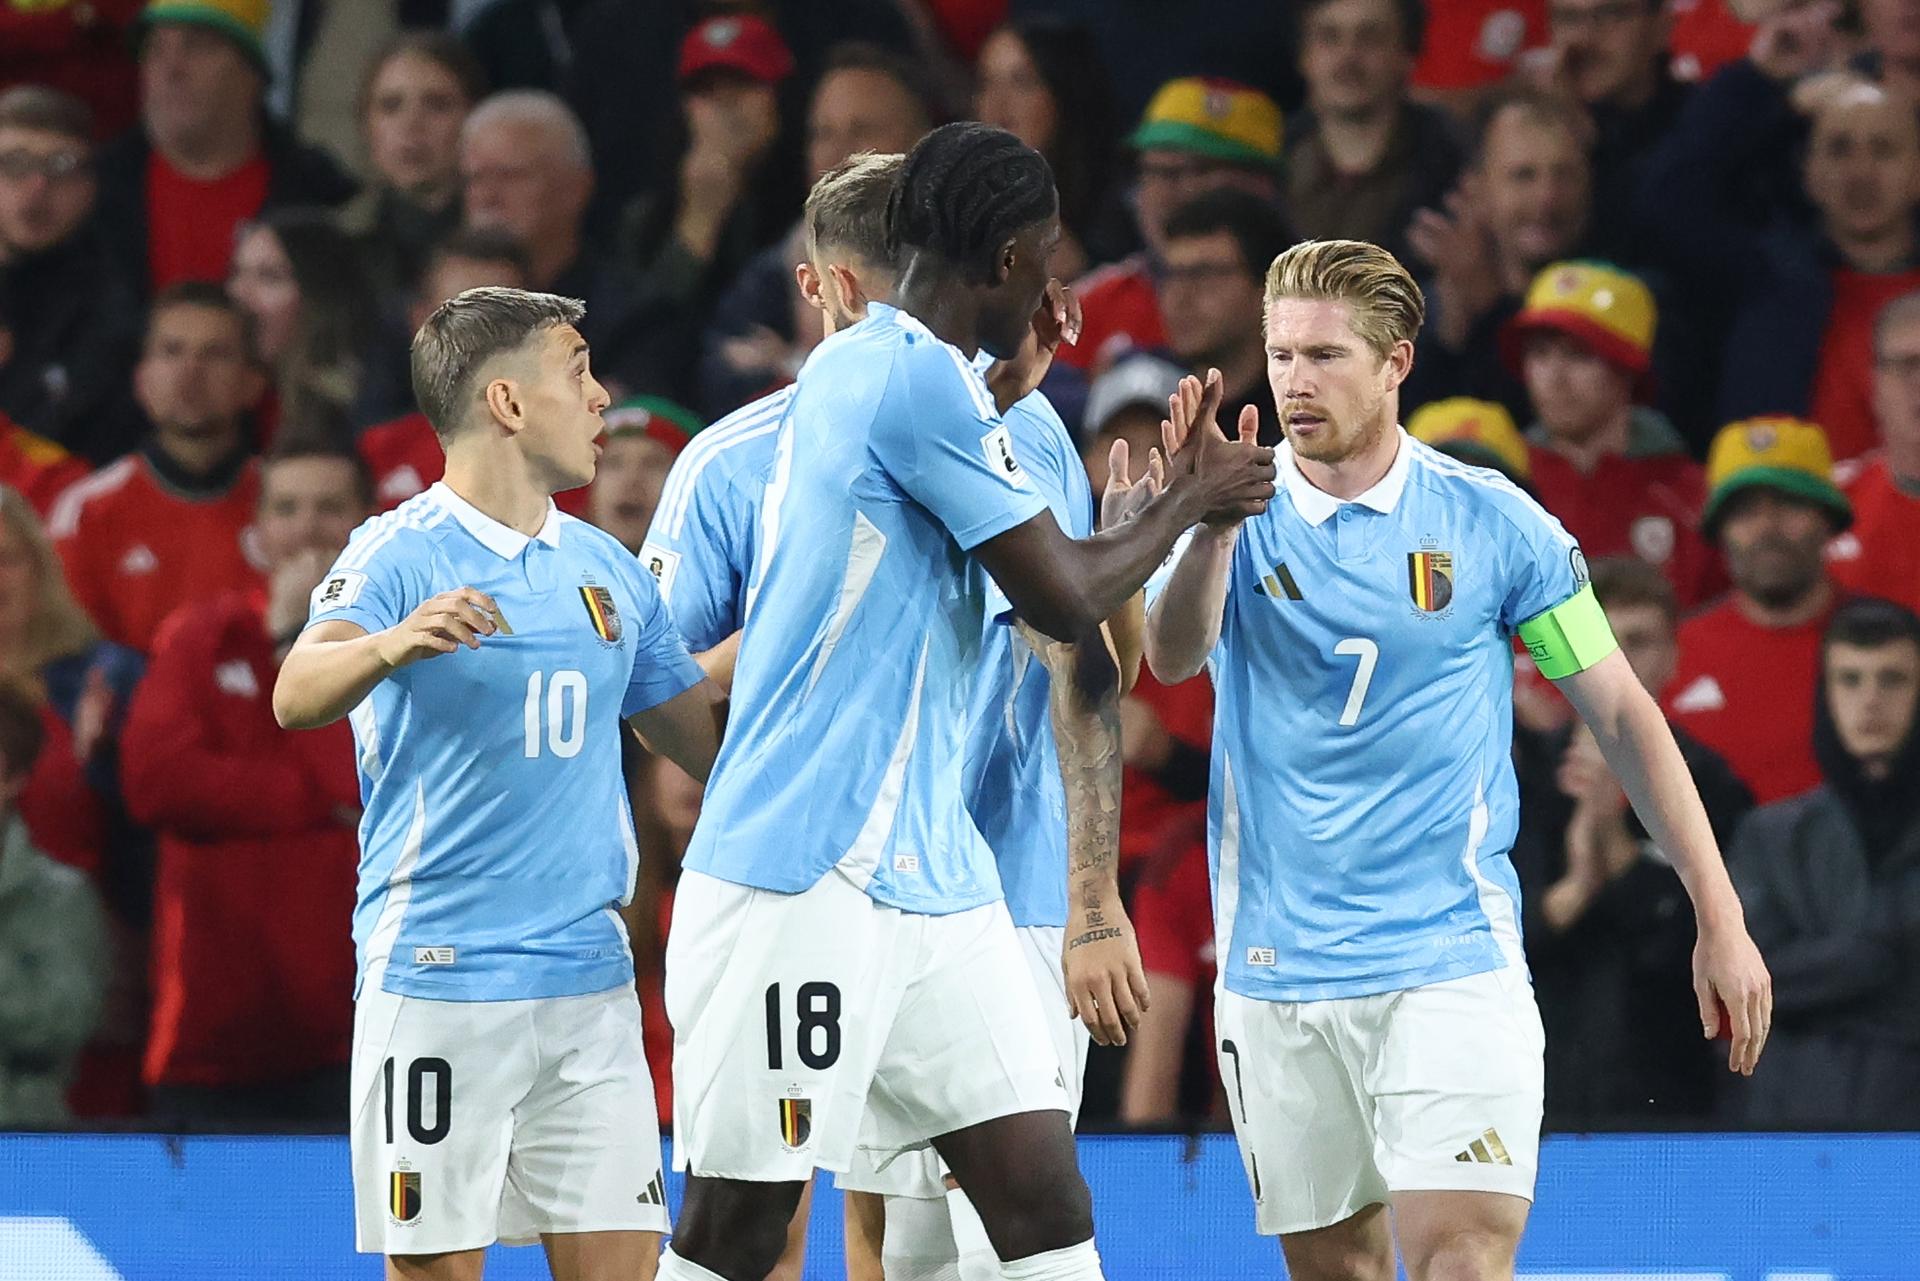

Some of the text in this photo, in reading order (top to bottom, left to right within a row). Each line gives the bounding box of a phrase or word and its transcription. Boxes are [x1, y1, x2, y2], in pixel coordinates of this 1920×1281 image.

[524, 670, 587, 758] 10
[1333, 637, 1379, 726] 7
[765, 981, 841, 1071] 18
[383, 1057, 452, 1144] 10
